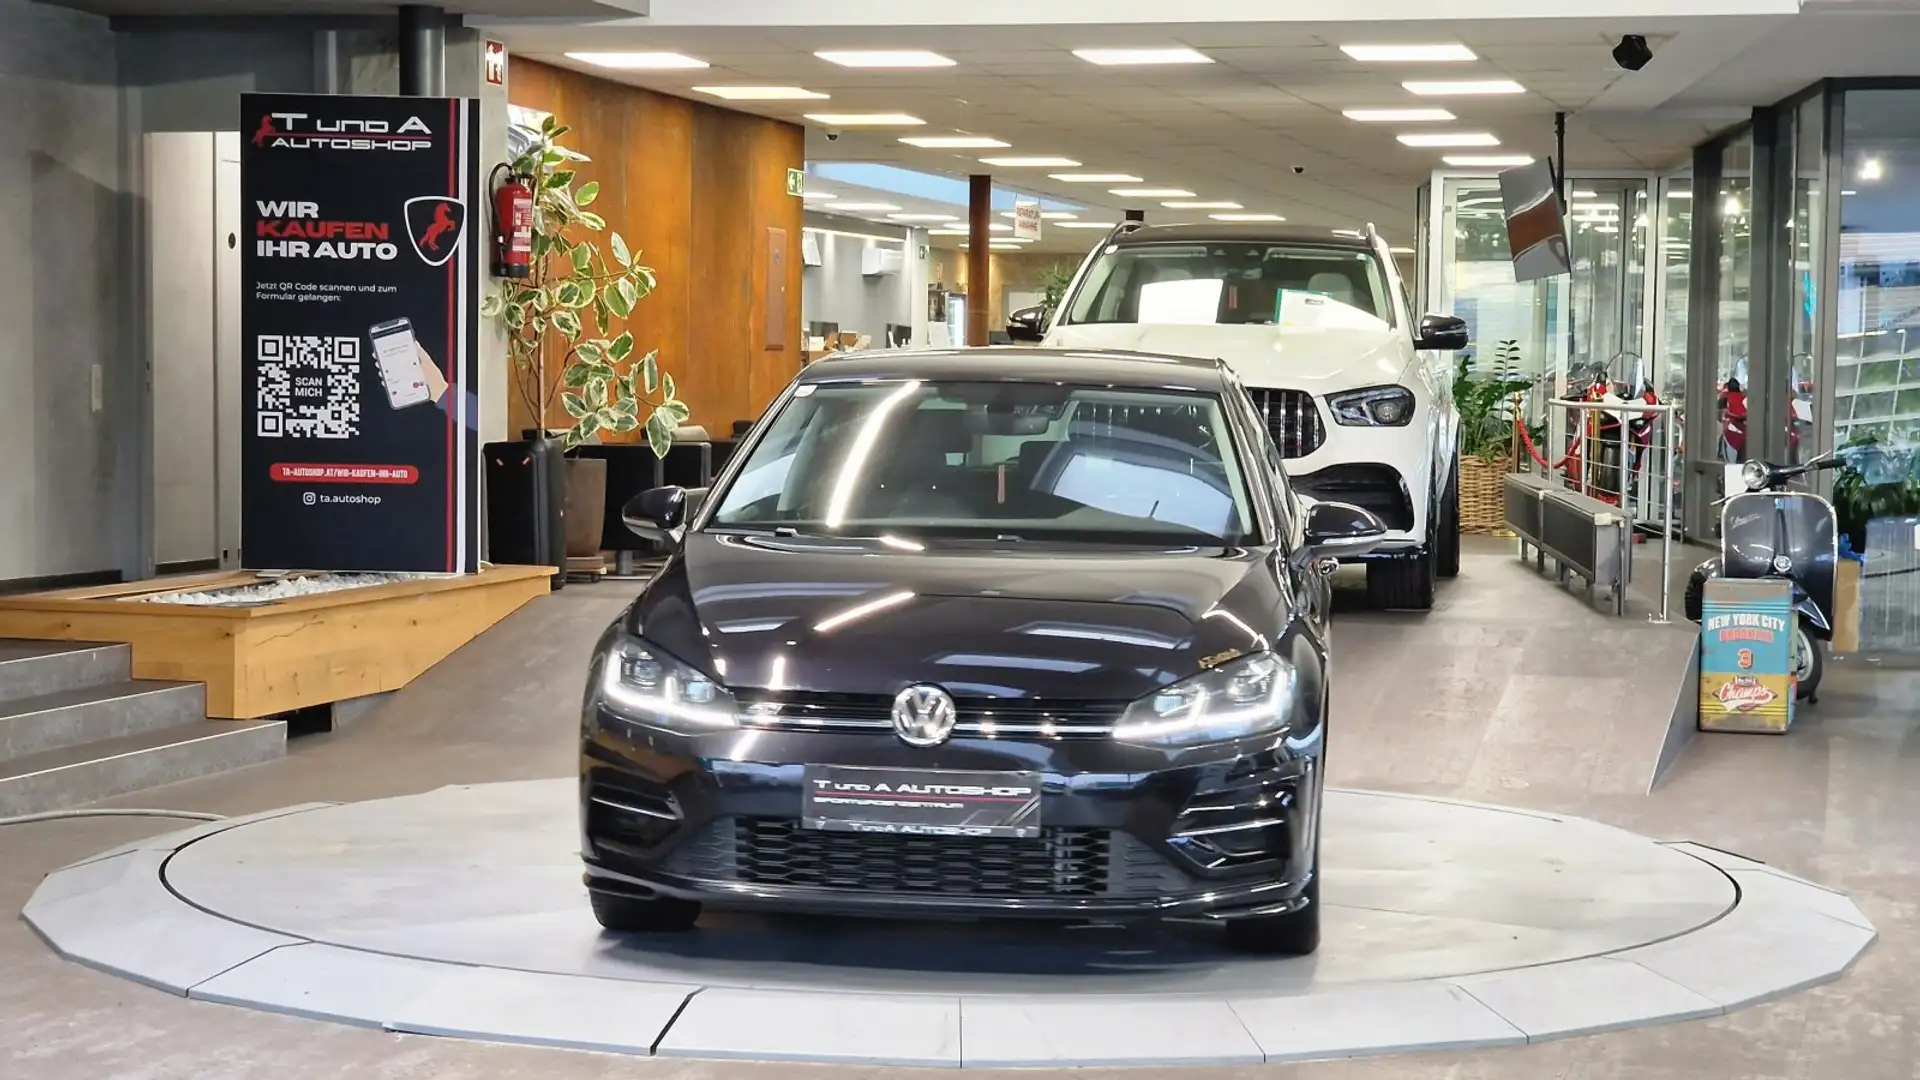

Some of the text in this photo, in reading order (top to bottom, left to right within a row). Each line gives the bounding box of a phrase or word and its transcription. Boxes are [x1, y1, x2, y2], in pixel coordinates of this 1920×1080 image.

[271, 112, 308, 131] T
[396, 116, 432, 134] A
[271, 137, 432, 151] AUTOSHOP
[256, 200, 319, 219] WIR
[256, 220, 389, 240] KAUFEN
[256, 240, 398, 260] IHR AUTO
[256, 282, 398, 293] Jetzt QR Code scannen und zum
[256, 292, 341, 302] Formular gelangen:
[295, 377, 323, 387] SCAN
[295, 387, 323, 397] MICH
[320, 494, 382, 505] ta.autoshop
[1708, 613, 1786, 632] NEW YORK CITY
[1737, 648, 1753, 669] 3
[813, 780, 831, 789] T
[873, 784, 892, 792] A
[896, 784, 1032, 796] AUTOSHOP
